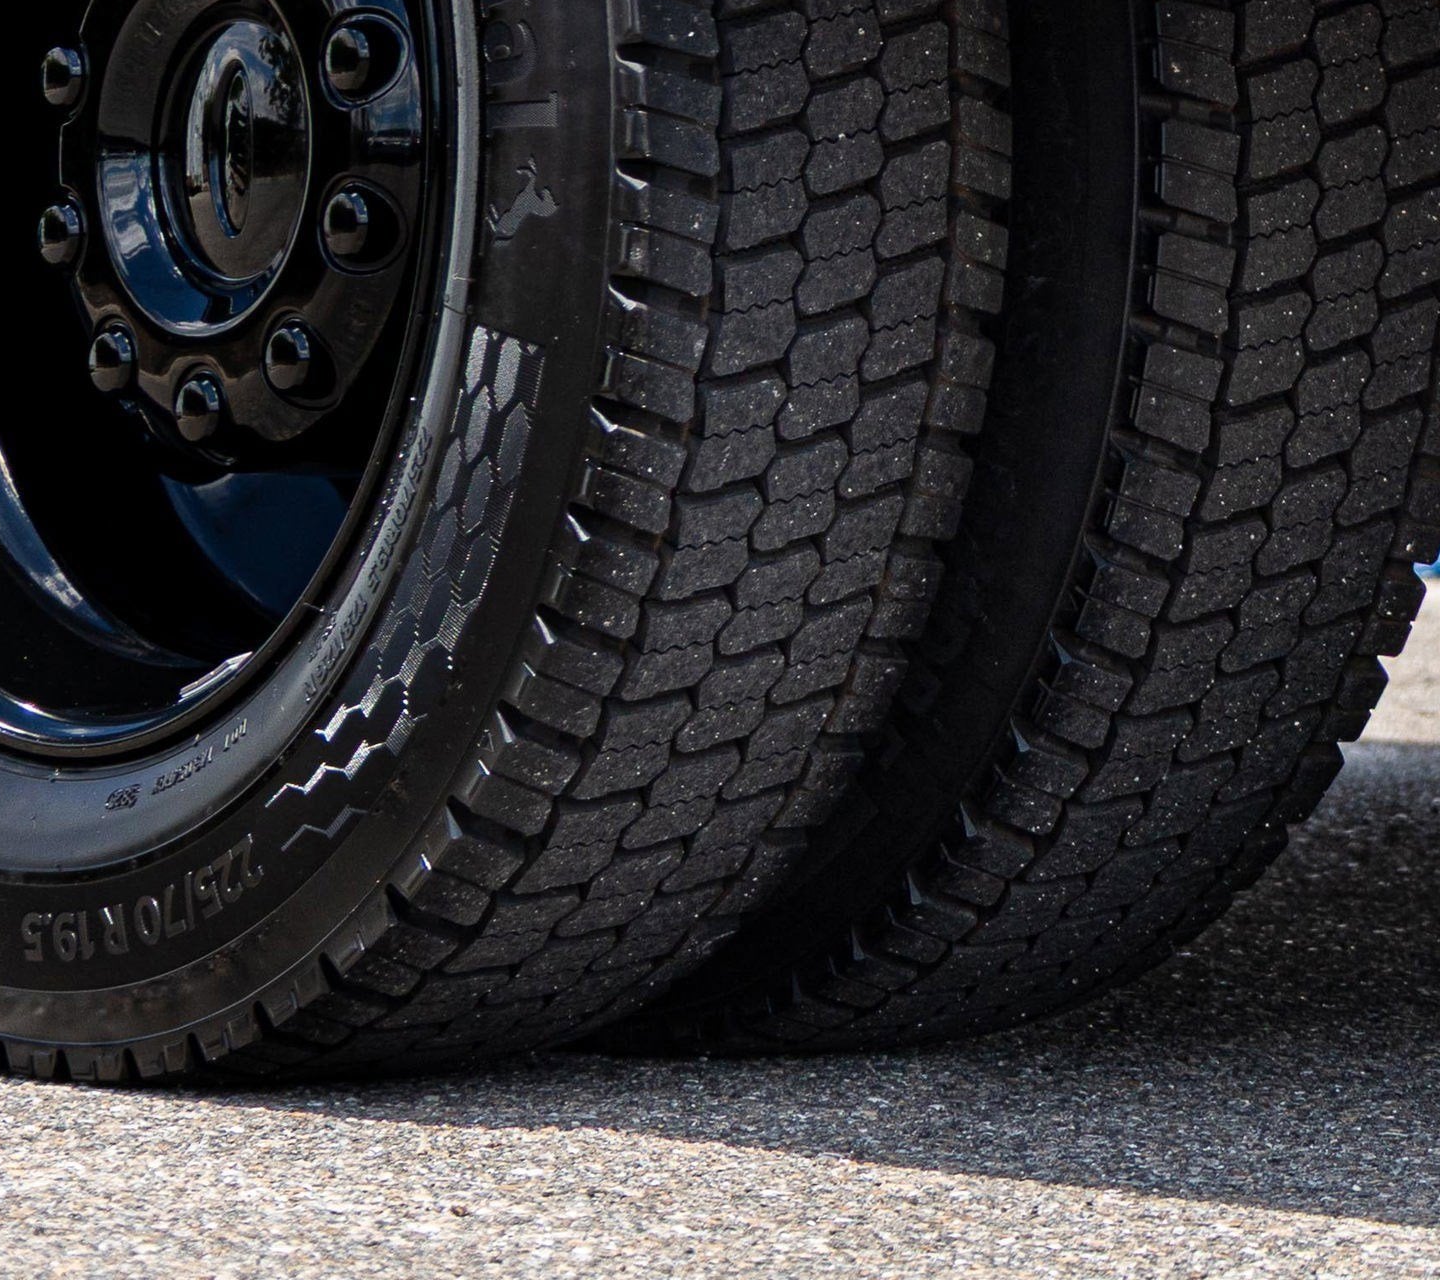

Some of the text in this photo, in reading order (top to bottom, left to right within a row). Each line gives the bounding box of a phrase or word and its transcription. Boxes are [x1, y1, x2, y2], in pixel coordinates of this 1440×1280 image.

[20, 832, 265, 963] 225/70 R 19.5
